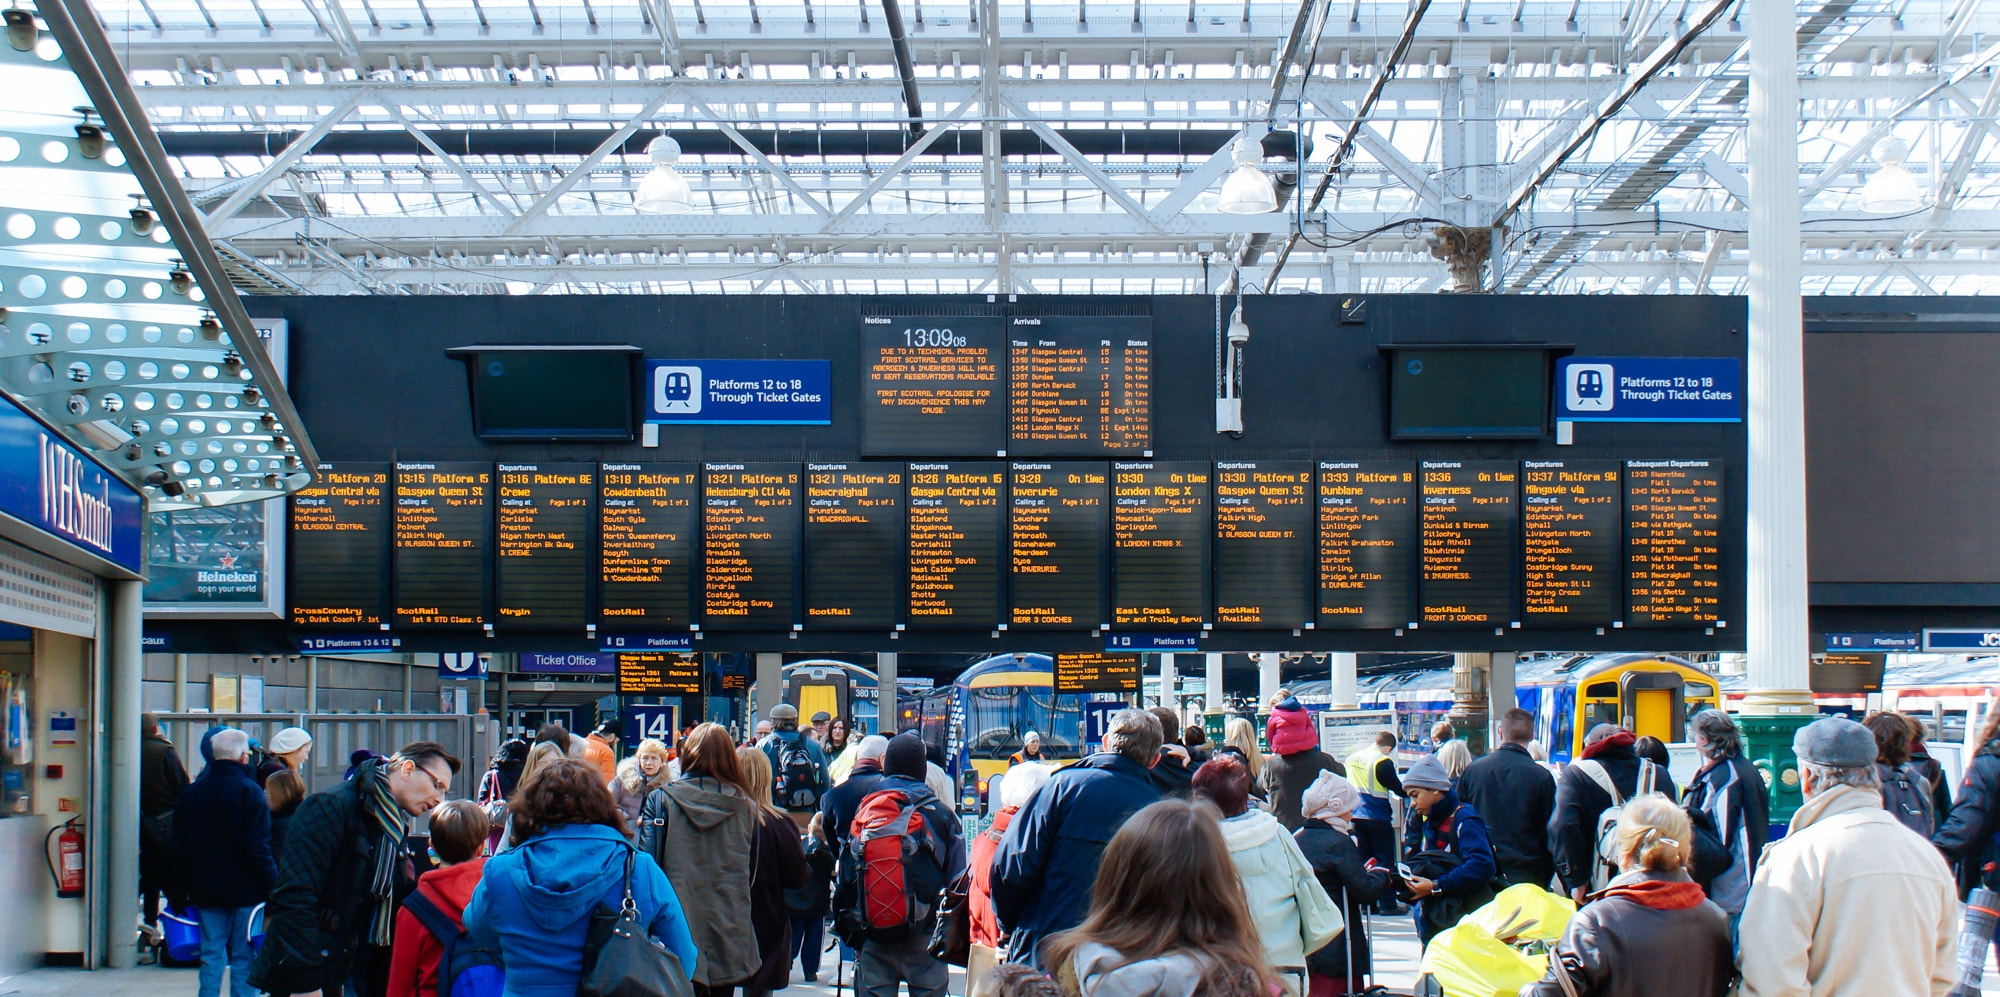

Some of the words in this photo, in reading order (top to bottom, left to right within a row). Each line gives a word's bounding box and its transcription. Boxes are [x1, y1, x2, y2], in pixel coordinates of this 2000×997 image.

[904, 329, 953, 347] 13:09
[953, 336, 966, 347] 08
[710, 379, 760, 389] Platforms
[763, 379, 774, 389] 12
[776, 380, 787, 389] to
[790, 379, 801, 389] 18
[1620, 377, 1671, 387] Platforms
[1673, 377, 1684, 387] 12
[1686, 378, 1698, 387] to
[1700, 377, 1712, 387] 18
[709, 392, 753, 404] Through
[757, 392, 789, 402] Ticket
[792, 392, 821, 402] Gates
[1620, 389, 1664, 401] Through
[1667, 390, 1699, 399] Ticket
[1701, 390, 1732, 400] Gates
[1032, 407, 1060, 415] Plymouth
[809, 463, 847, 471] Departures
[1218, 462, 1256, 470] Departures
[1627, 460, 1669, 468] Subsequent
[1670, 460, 1709, 468] Departures
[399, 474, 425, 483] 13:15
[432, 474, 473, 483] Platform
[479, 474, 488, 483] 15
[503, 474, 528, 484] 13:16
[534, 474, 575, 484] Platform
[580, 475, 591, 484] 8E
[605, 475, 631, 484] 13:18
[639, 475, 679, 484] Platform
[685, 475, 694, 484] 17
[708, 474, 732, 484] 13:21
[742, 474, 782, 484] Platform
[788, 474, 797, 483] 13
[811, 474, 835, 484] 13:21
[843, 474, 884, 484] Platform
[888, 474, 900, 484] 20
[1015, 474, 1041, 483] 13:28
[1068, 474, 1080, 483] On
[1085, 474, 1104, 483] time
[1117, 474, 1143, 483] 13:30
[1171, 474, 1183, 483] On
[1187, 474, 1207, 483] time
[1322, 473, 1348, 482] 13:33
[1356, 473, 1397, 482] Platform
[1403, 473, 1412, 482] 18
[1425, 473, 1451, 482] 13:36
[1478, 472, 1490, 481] On
[1495, 472, 1514, 481] time
[1527, 472, 1553, 481] 13:37
[1559, 472, 1600, 481] Platform
[39, 432, 113, 553] WHSmith
[397, 487, 435, 497] Glasgow
[439, 487, 468, 496] Queen
[472, 487, 483, 496] St
[501, 487, 530, 496] Crewe
[604, 487, 666, 497] Cowdenbeath
[706, 487, 758, 498] Helensburgh
[761, 487, 774, 496] Ctl
[777, 487, 790, 496] via
[809, 487, 868, 498] Newcraighall
[911, 487, 944, 497] Glasgow
[947, 487, 979, 496] Central
[982, 487, 995, 496] via
[1013, 487, 1058, 496] Inverurie
[1116, 486, 1151, 496] London
[1154, 486, 1180, 497] Kings
[1184, 486, 1191, 495] X
[1218, 486, 1255, 496] Glasgow
[1259, 486, 1289, 495] Queen
[1293, 486, 1304, 495] St
[1321, 486, 1363, 495] Dunblane
[1424, 485, 1471, 495] Inverness
[1526, 485, 1567, 495] Milngavie
[1571, 485, 1584, 494] via
[397, 515, 437, 523] Linlithgow
[603, 524, 633, 532] Dalmeny
[706, 524, 731, 532] Uphall
[706, 541, 739, 549] Bathgate
[1321, 565, 1353, 573] Stirling
[198, 571, 257, 582] Heineken
[218, 586, 235, 594] your
[294, 608, 362, 617] CrossCountry
[500, 608, 530, 616] Virgin
[326, 639, 361, 647] Platforms
[535, 654, 565, 666] Ticket
[567, 654, 597, 666] Office
[635, 713, 669, 740] 14
